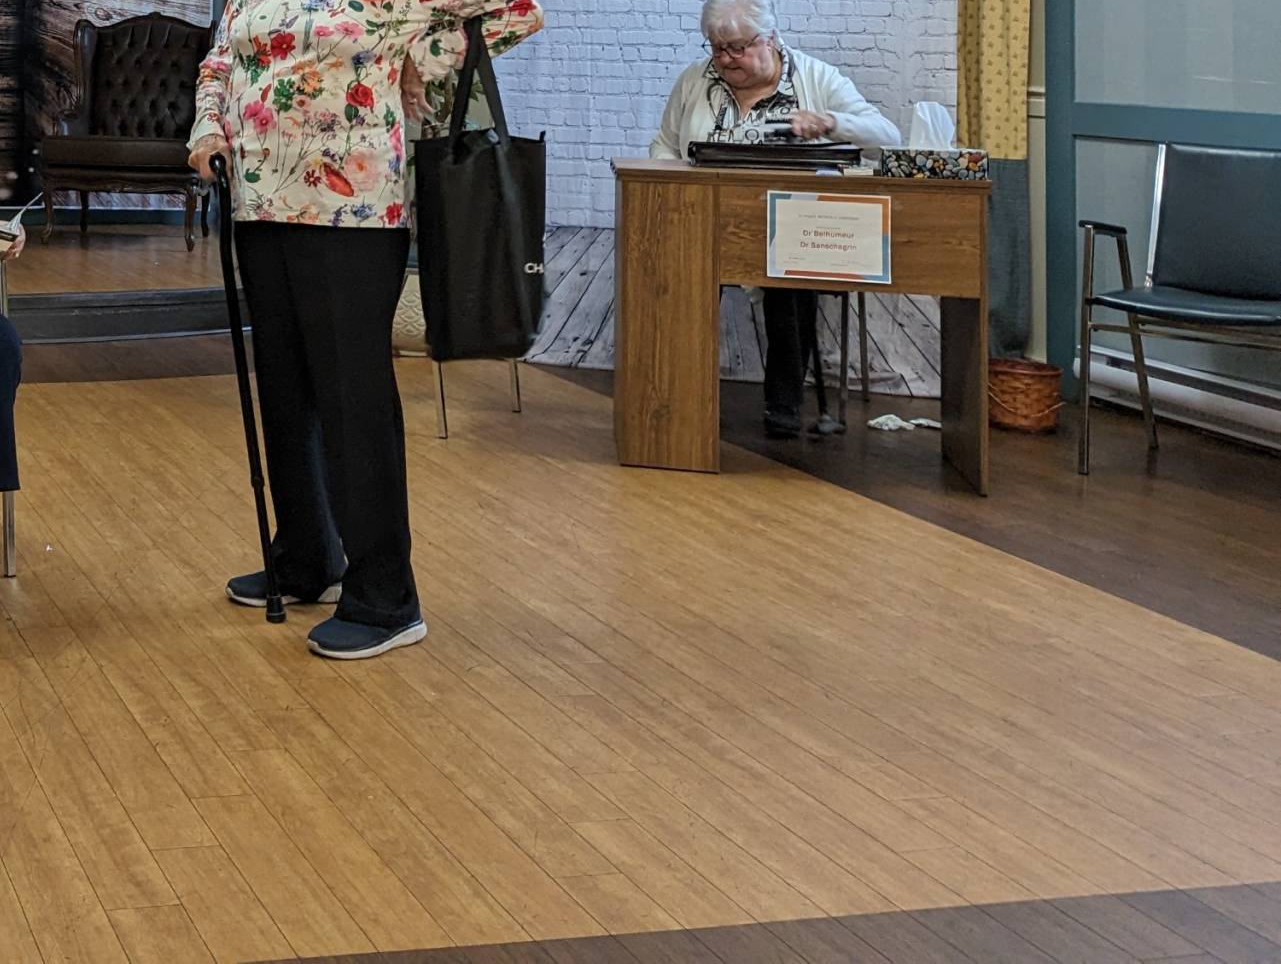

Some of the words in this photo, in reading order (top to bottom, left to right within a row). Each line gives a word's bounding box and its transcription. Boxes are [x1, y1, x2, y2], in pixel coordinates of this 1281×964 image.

[802, 229, 812, 237] Dr
[814, 230, 854, 239] Belhumeur
[800, 241, 809, 249] Dr
[810, 242, 857, 252] Sanschagrin
[524, 262, 544, 274] CH
